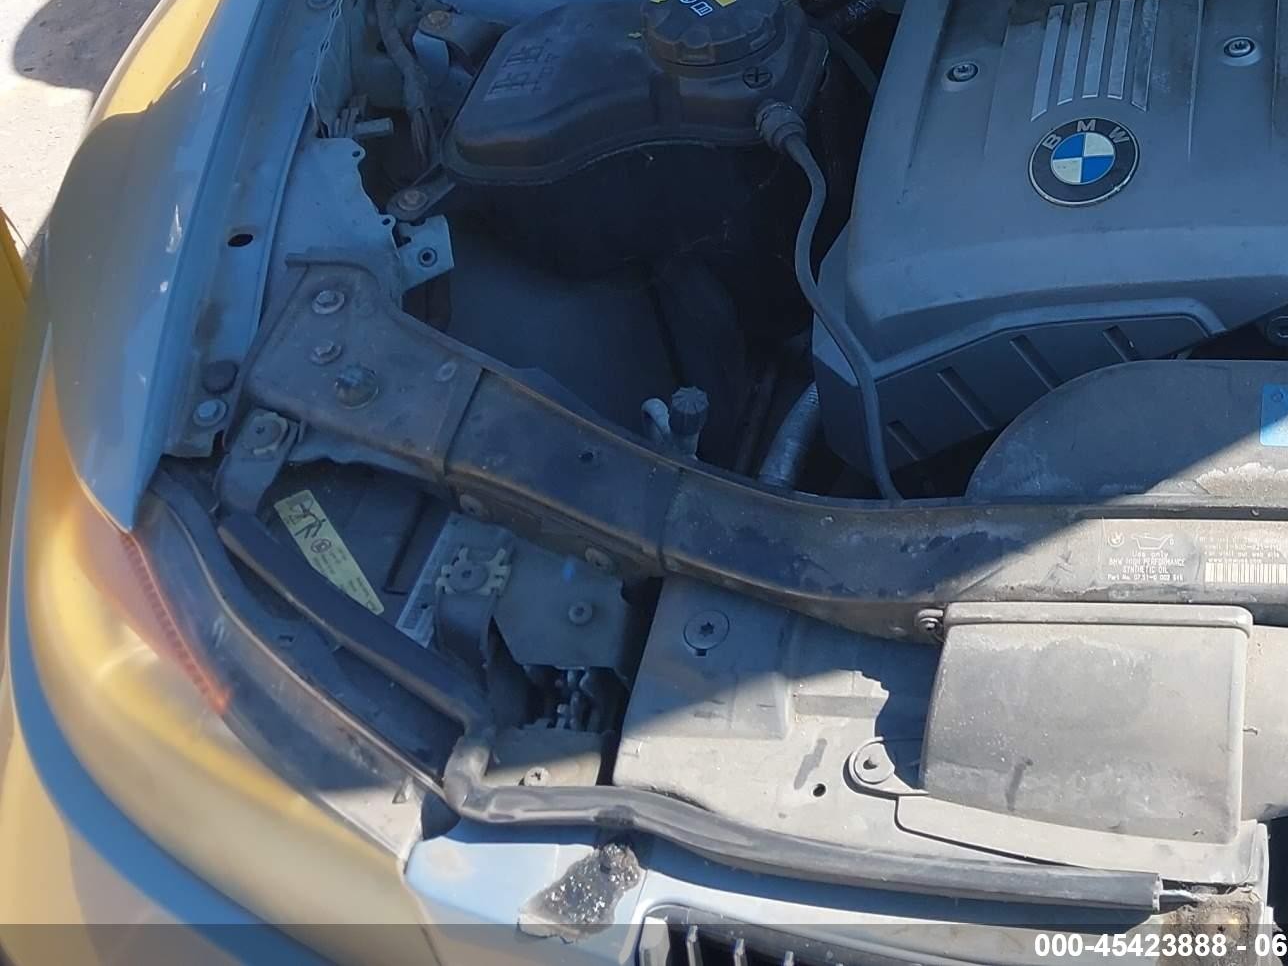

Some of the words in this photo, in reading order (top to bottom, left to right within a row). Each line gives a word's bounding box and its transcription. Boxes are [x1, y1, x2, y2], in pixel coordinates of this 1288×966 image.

[1042, 119, 1130, 150] BMW
[1152, 549, 1169, 560] only
[1158, 565, 1169, 574] OIL
